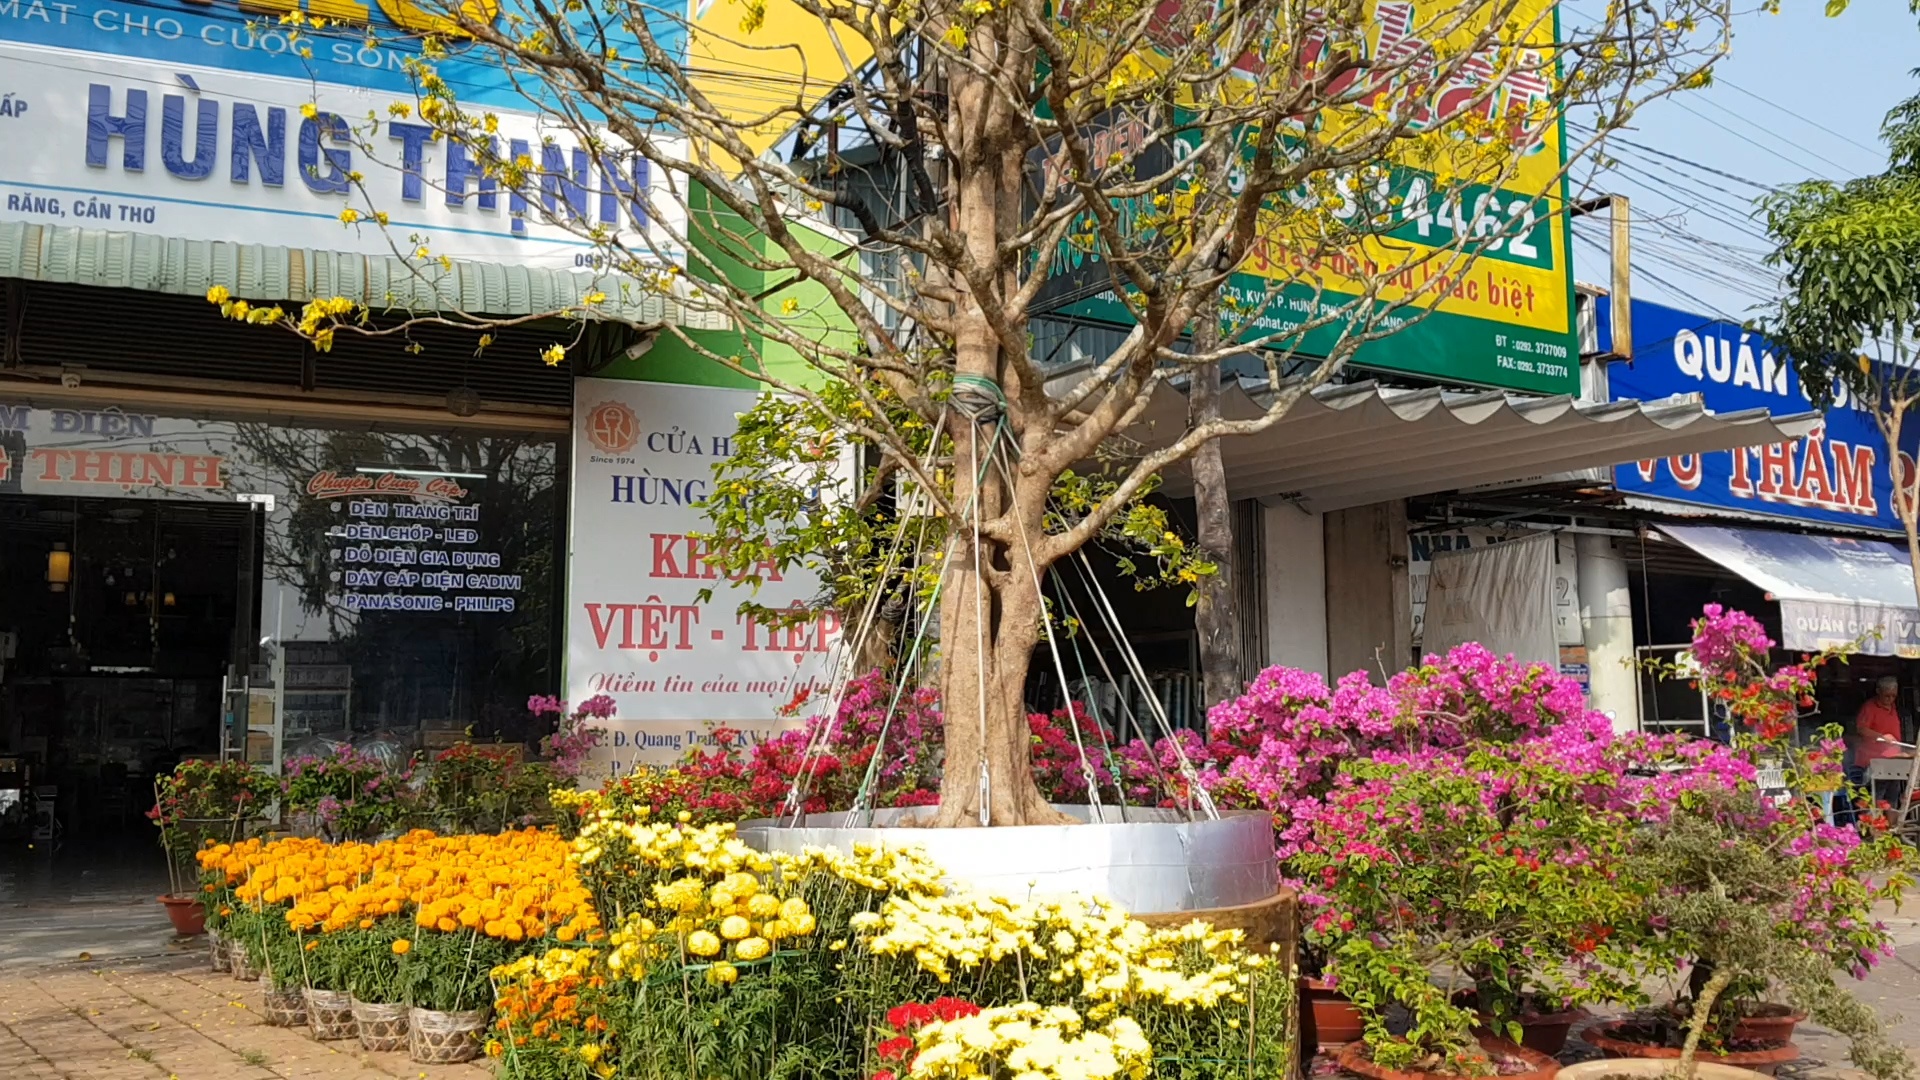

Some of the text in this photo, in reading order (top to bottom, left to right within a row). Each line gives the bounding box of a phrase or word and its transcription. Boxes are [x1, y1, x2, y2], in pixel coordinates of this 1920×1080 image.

[93, 9, 183, 38] CHO
[200, 24, 314, 58] CUỘC
[86, 73, 650, 233] HÙNG THỊNH
[8, 192, 66, 218] RĂNG,
[118, 204, 156, 224] THƠ
[1487, 271, 1535, 317] biệt
[1535, 341, 1567, 358] 3737009
[1674, 328, 1788, 396] QUÁN
[1536, 362, 1568, 378] 3733774
[647, 425, 704, 456] CỬA
[31, 448, 225, 491] THỊNH
[590, 455, 636, 466] Since 1974
[307, 471, 374, 499] Chuyên
[375, 471, 421, 493] Cung
[610, 467, 709, 506] HÙNG
[394, 504, 450, 520] TRANG
[453, 503, 480, 521] TRÍ
[445, 528, 478, 543] LED
[419, 551, 449, 565] GIA
[452, 551, 500, 569] DỤNG
[344, 568, 383, 586] DÂY
[466, 574, 522, 591] CADIVI
[344, 594, 443, 611] PANASONIC
[455, 597, 515, 612] PHILIPS
[584, 595, 700, 663] VIỆT
[736, 599, 842, 664] TIỆP
[588, 671, 658, 694] Niềm
[663, 673, 694, 693] tin
[700, 674, 740, 694] của
[747, 675, 787, 698] mọi
[614, 730, 630, 747] Đ.
[634, 730, 682, 750] Quang
